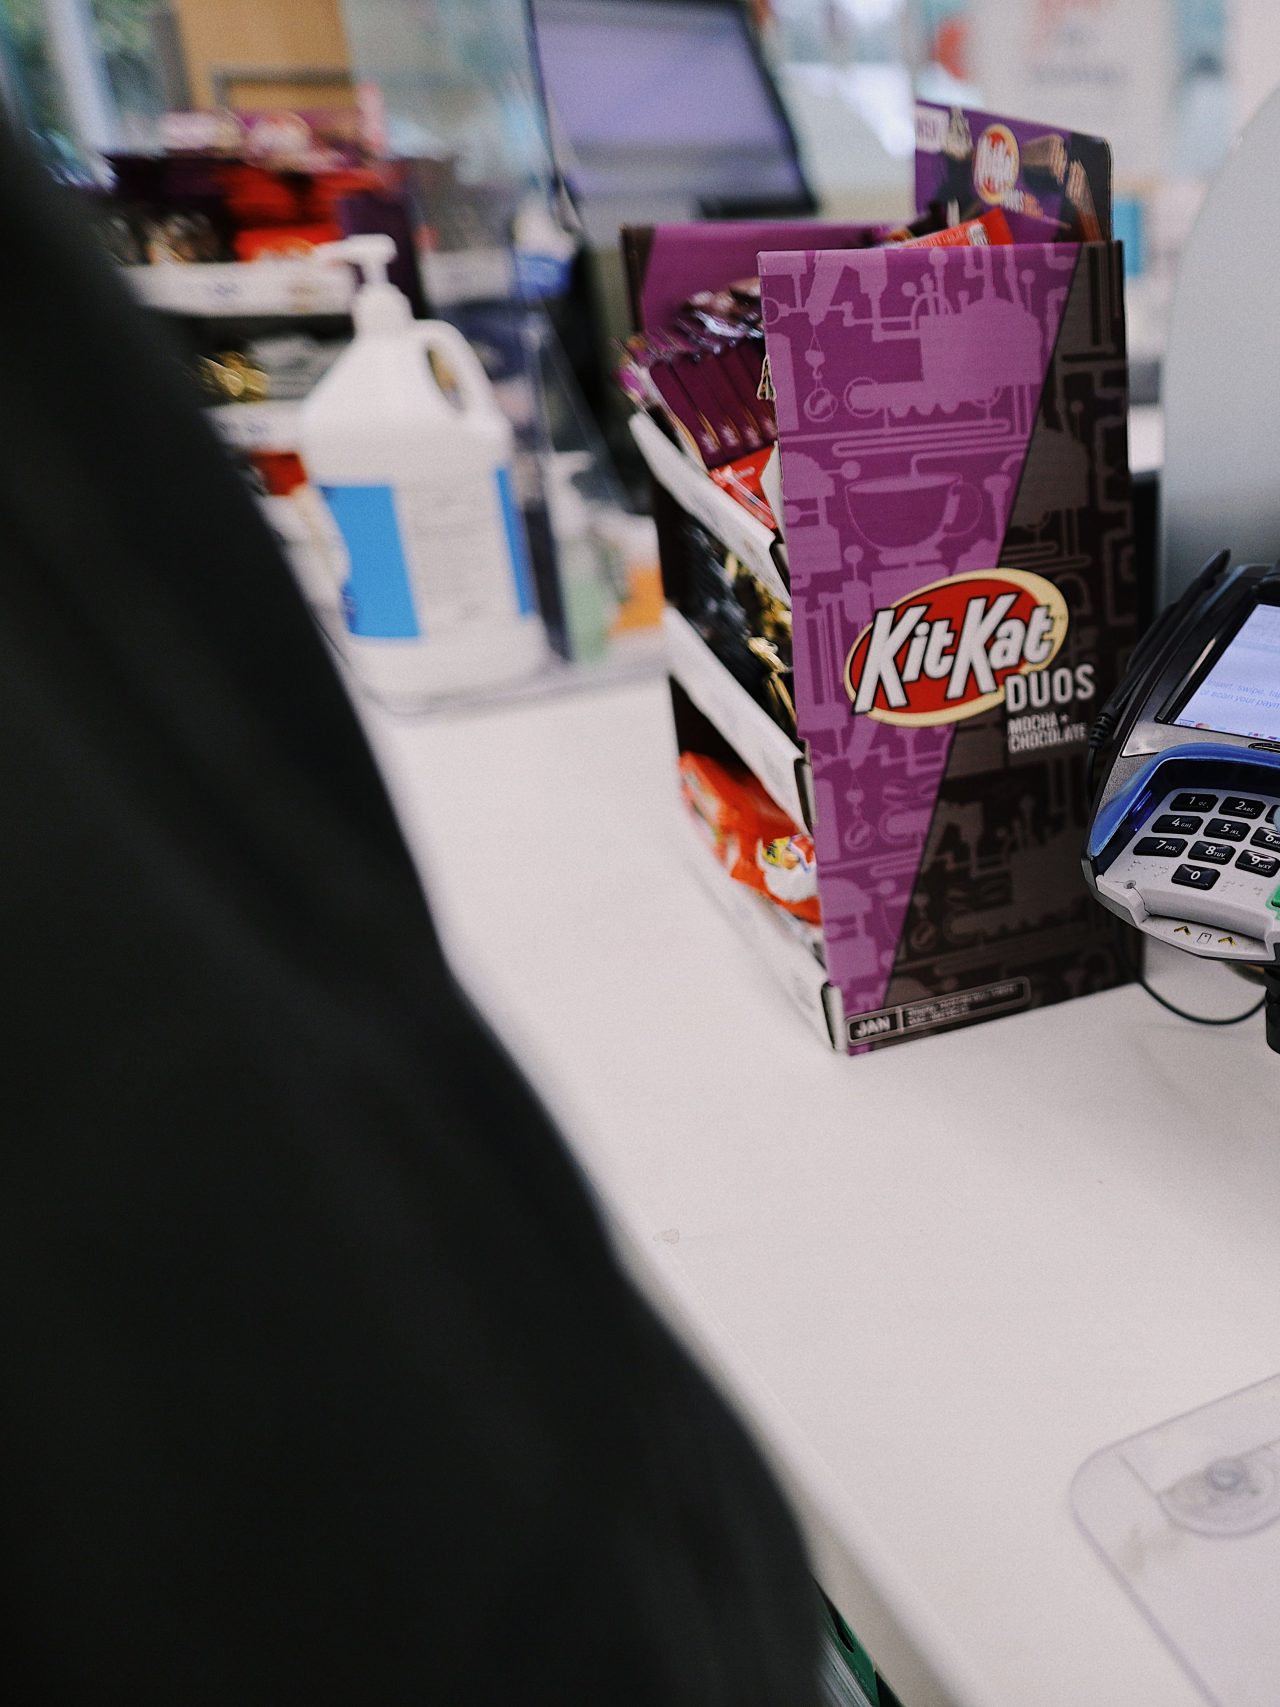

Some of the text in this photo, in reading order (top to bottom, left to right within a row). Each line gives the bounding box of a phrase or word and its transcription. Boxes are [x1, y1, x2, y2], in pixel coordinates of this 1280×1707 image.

[1005, 663, 1097, 713] DUOS
[1210, 690, 1234, 700] scan
[1233, 694, 1256, 706] your
[1007, 711, 1059, 735] MOCHA
[1008, 721, 1089, 754] CHOCOLATE
[1189, 796, 1197, 805] 1
[1235, 801, 1244, 811] 2
[1171, 817, 1181, 827] 4
[1220, 823, 1230, 833] 5
[1264, 829, 1275, 842] 6
[1155, 839, 1166, 850] 7
[1205, 844, 1216, 856] 8
[855, 1016, 891, 1038] JAN
